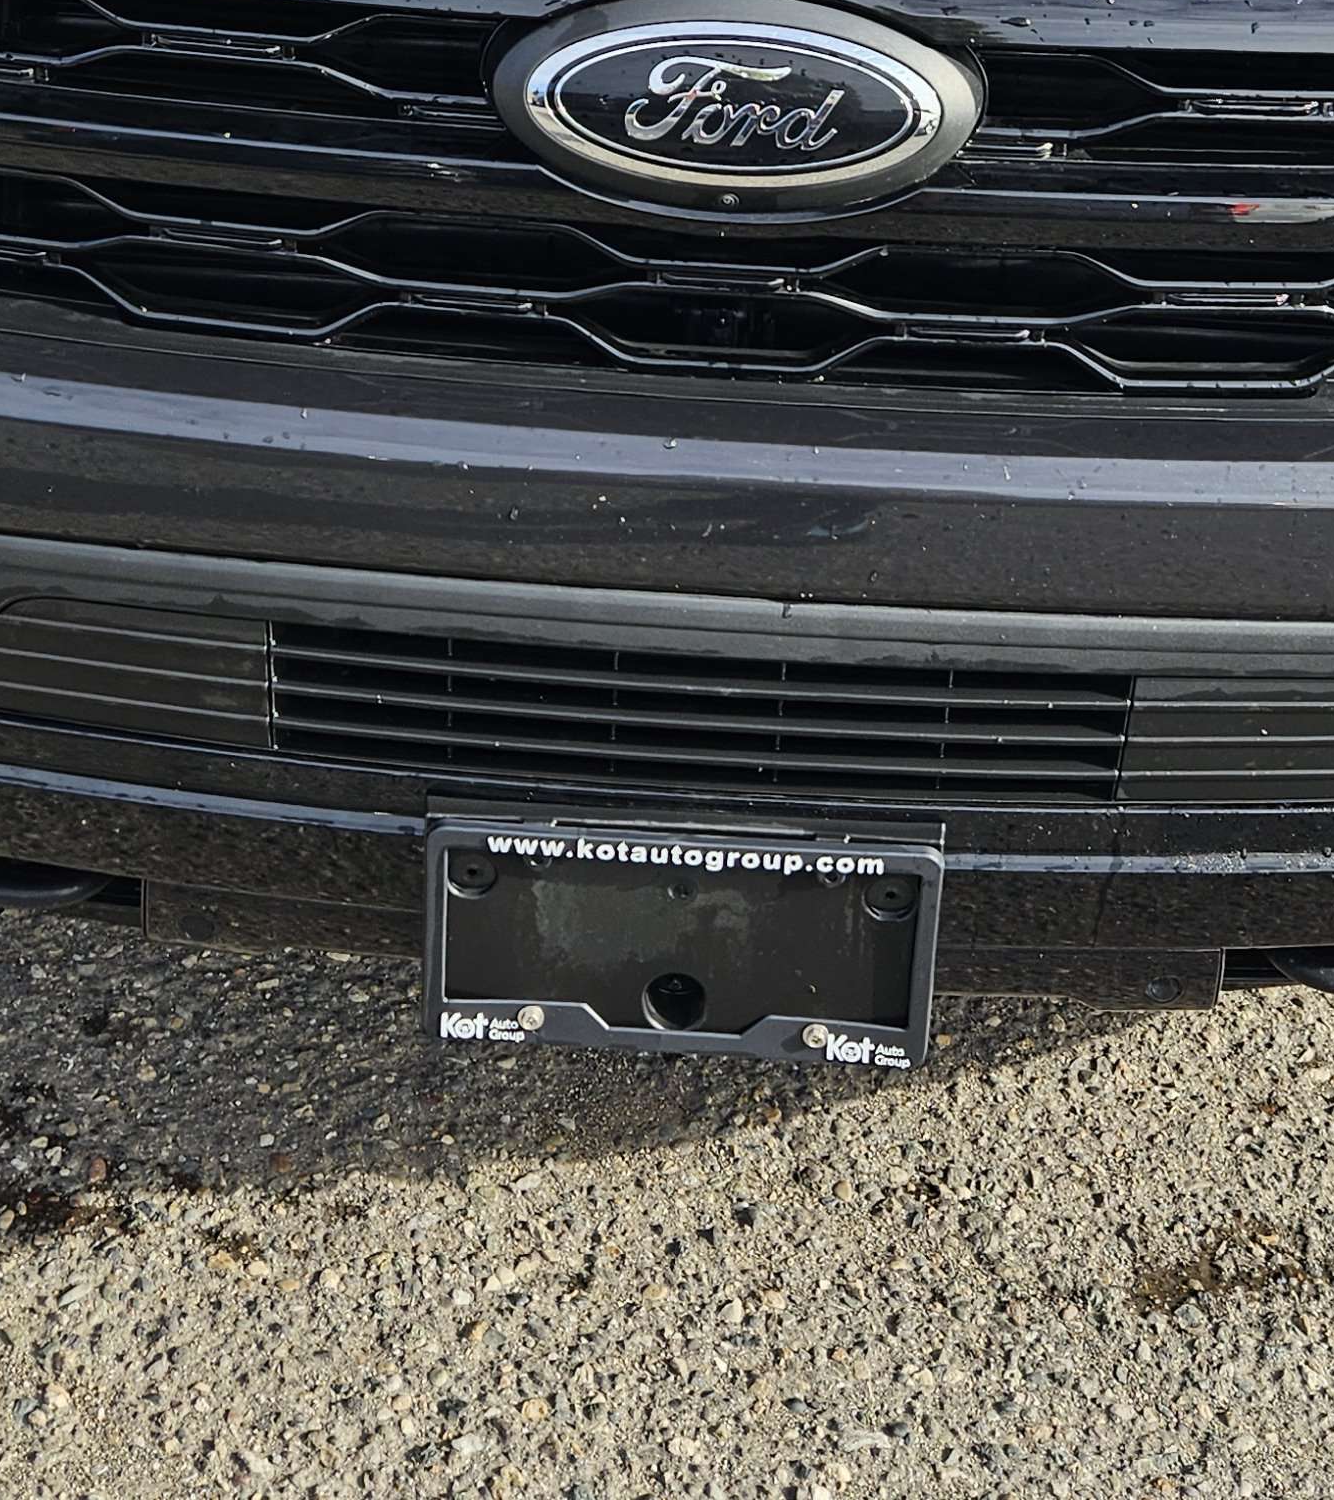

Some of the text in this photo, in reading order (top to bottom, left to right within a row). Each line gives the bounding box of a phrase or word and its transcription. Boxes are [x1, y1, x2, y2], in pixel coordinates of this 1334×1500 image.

[624, 55, 845, 151] Ford
[487, 835, 885, 876] www.kotautogroup.com
[440, 1011, 526, 1043] Kot Auto Group
[826, 1033, 912, 1070] Kot Auto Group
